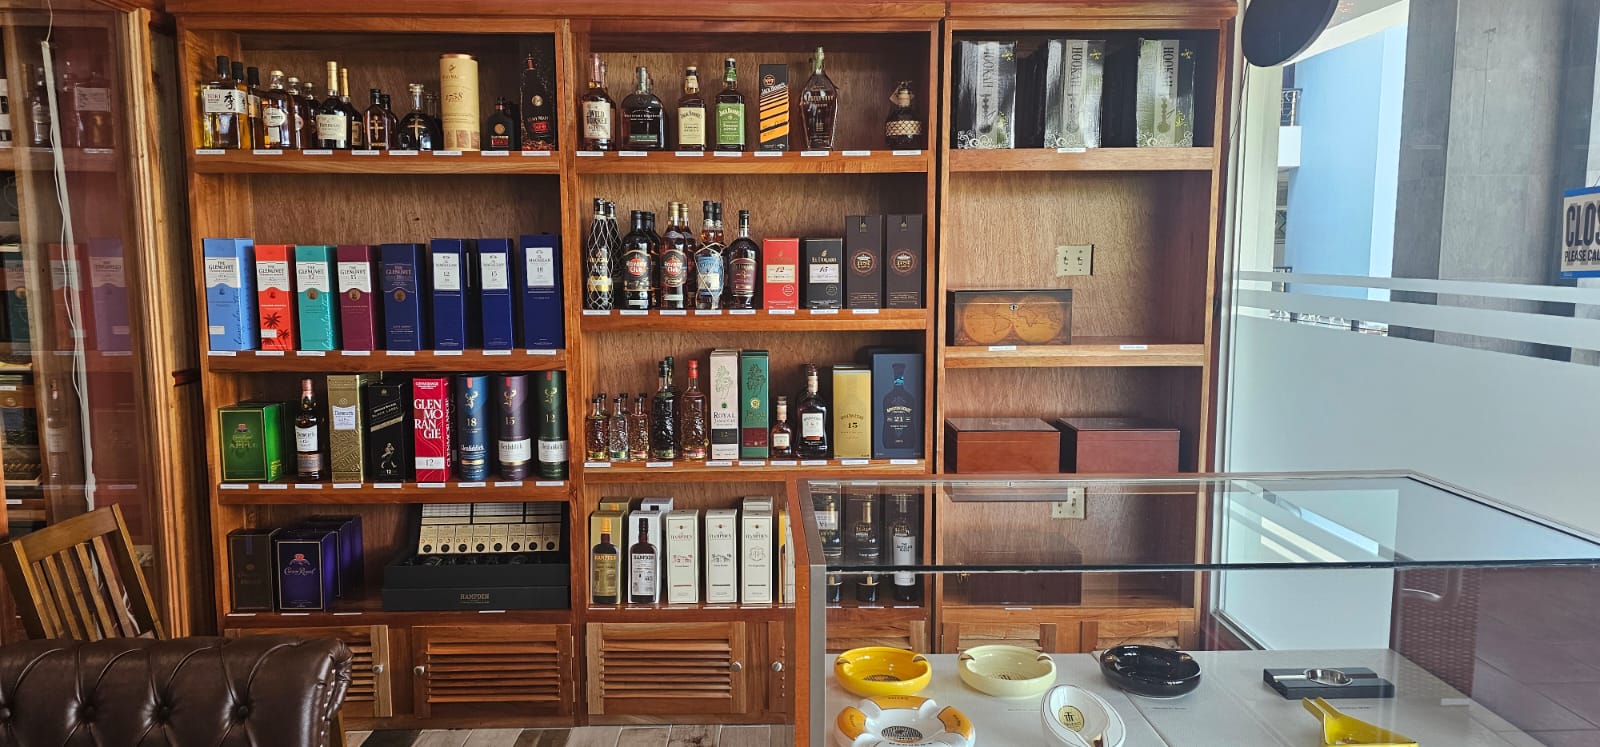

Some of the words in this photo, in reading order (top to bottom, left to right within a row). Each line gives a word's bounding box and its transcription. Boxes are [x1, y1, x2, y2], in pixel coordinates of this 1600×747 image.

[983, 48, 994, 88] HOOKAH
[1071, 47, 1082, 87] HOOKAH
[1565, 250, 1587, 262] PLEASE
[414, 398, 442, 410] GLEN
[423, 409, 443, 420] MO
[546, 414, 556, 423] 12
[713, 411, 736, 419] ROYAL
[414, 419, 436, 429] RAN
[467, 417, 478, 427] 18
[505, 416, 516, 425] 15
[423, 429, 442, 439] GIE
[425, 458, 434, 467] 12
